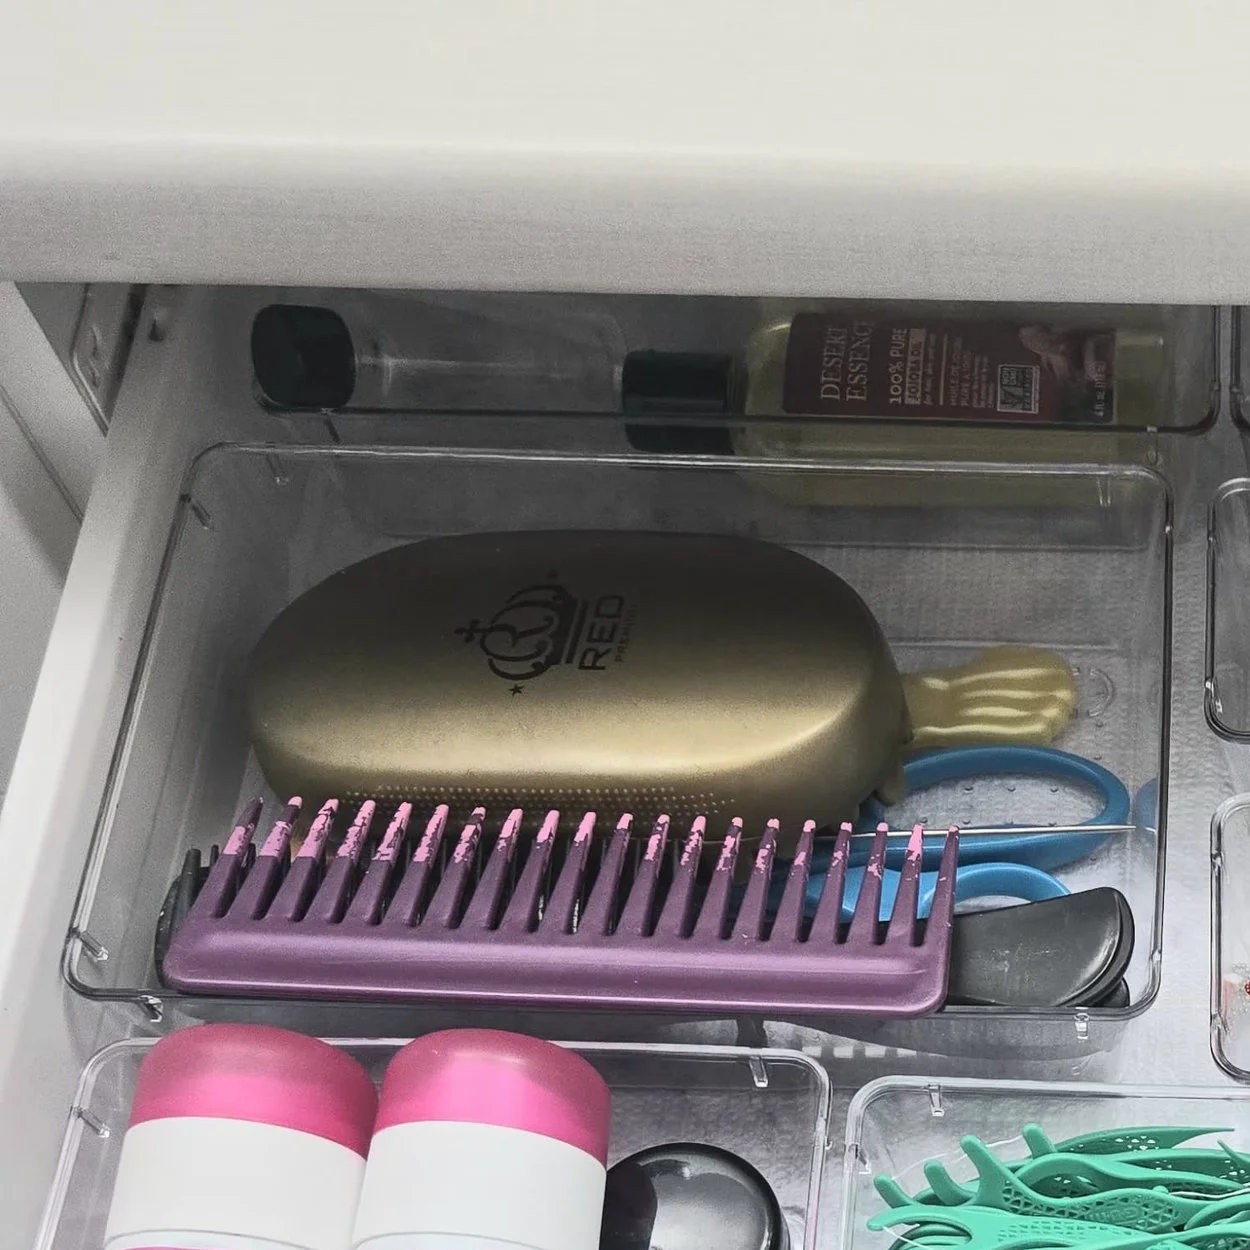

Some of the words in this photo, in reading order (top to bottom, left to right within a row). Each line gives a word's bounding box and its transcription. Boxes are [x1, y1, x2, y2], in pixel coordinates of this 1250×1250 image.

[892, 326, 909, 361] PURE
[889, 364, 908, 405] 100%
[577, 594, 625, 671] RED
